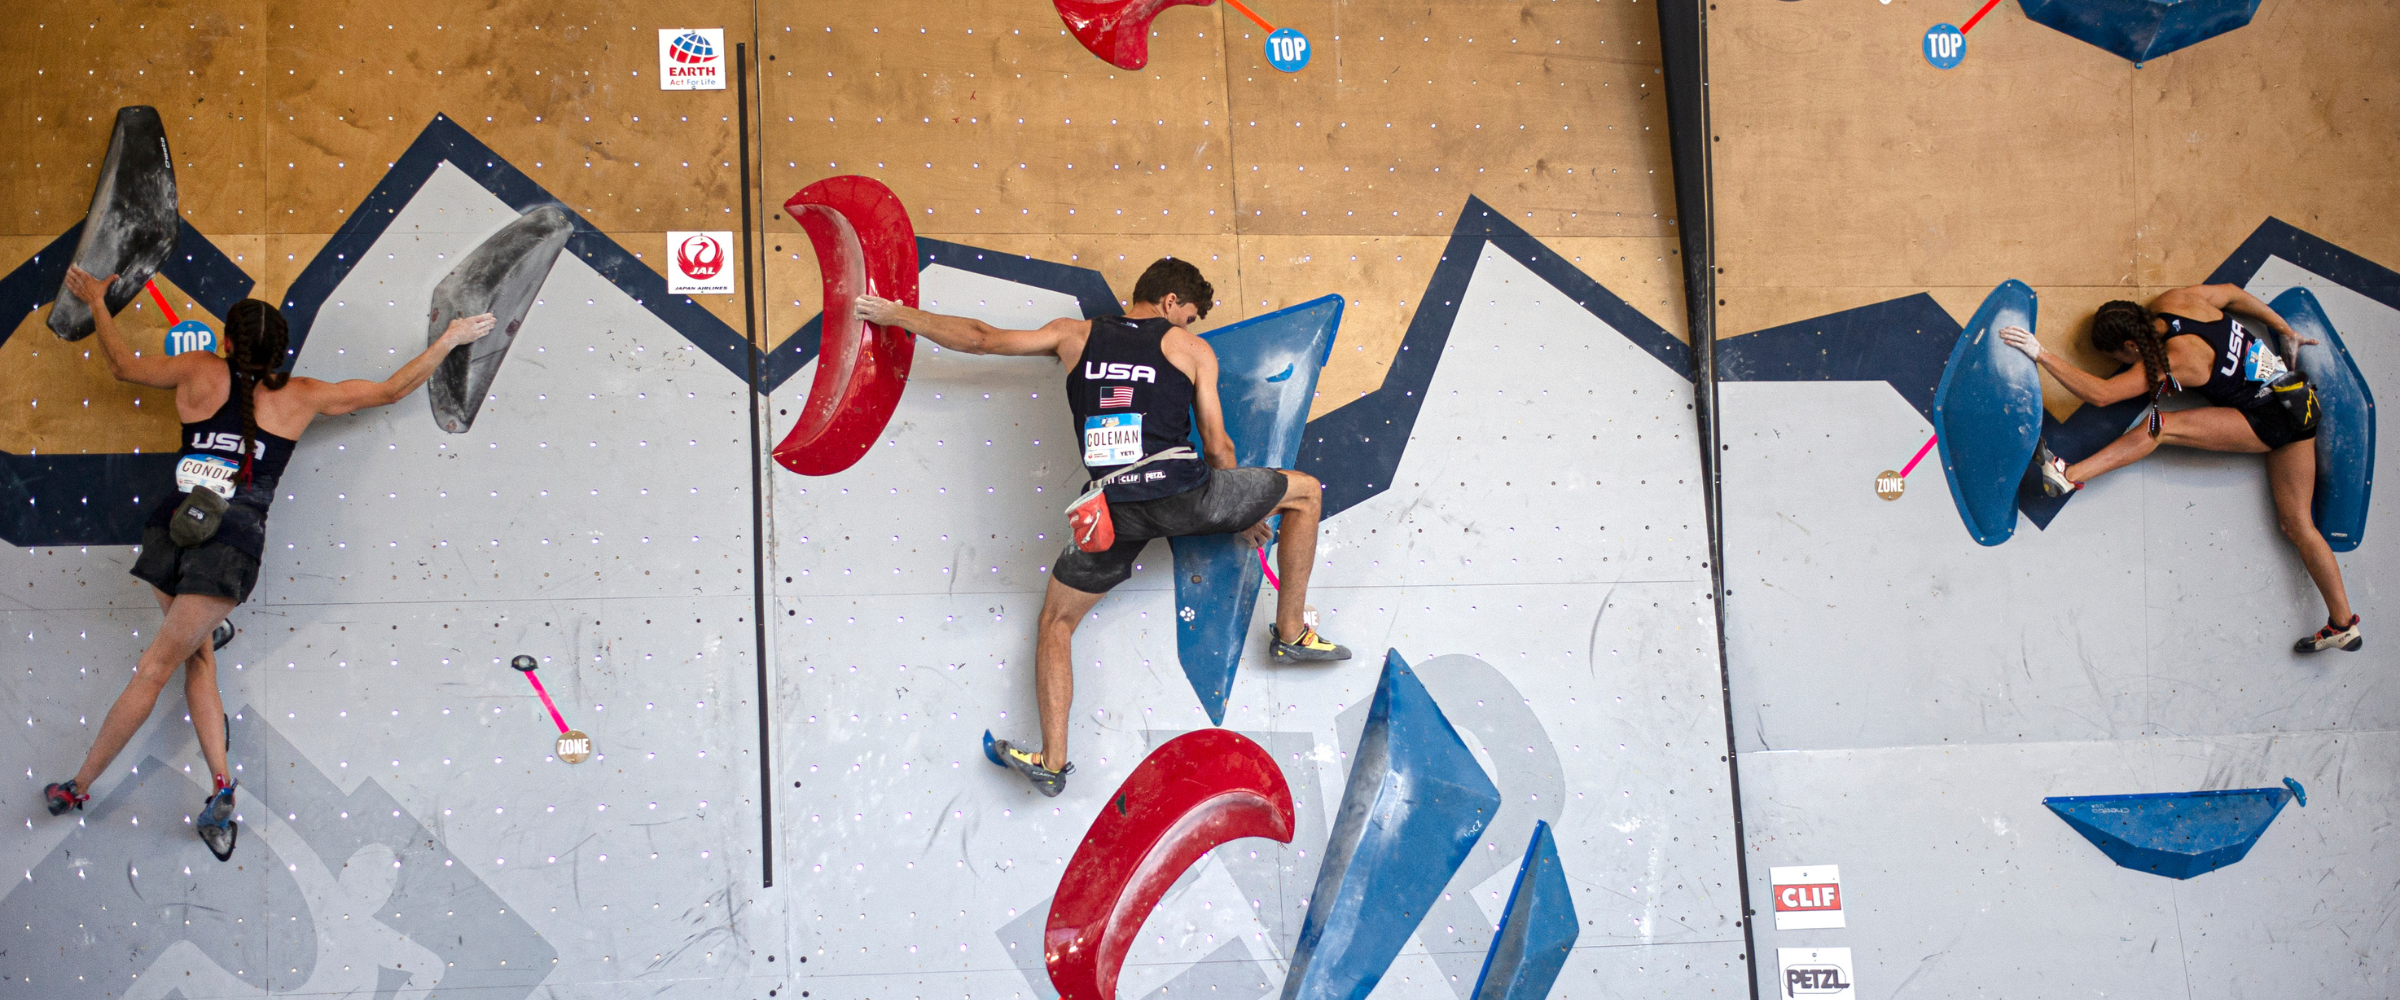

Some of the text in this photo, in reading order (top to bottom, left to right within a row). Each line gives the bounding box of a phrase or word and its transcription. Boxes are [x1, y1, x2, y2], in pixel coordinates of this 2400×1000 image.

[1270, 37, 1306, 61] TOP
[1928, 33, 1962, 58] TOP
[669, 66, 716, 77] EARTH
[690, 266, 716, 275] JAL
[171, 331, 212, 356] TOP
[2220, 319, 2245, 377] USA
[1084, 361, 1156, 384] USA
[191, 432, 266, 460] USA
[1087, 430, 1139, 448] COLEMAN
[182, 460, 235, 481] CONDI
[1120, 474, 1139, 483] CLIF
[1145, 471, 1167, 483] PETZL
[1877, 477, 1904, 493] ZONE
[1303, 611, 1319, 626] NE
[558, 738, 590, 755] ZONE
[1782, 887, 1835, 908] CLIF
[1786, 969, 1850, 998] PETZL
